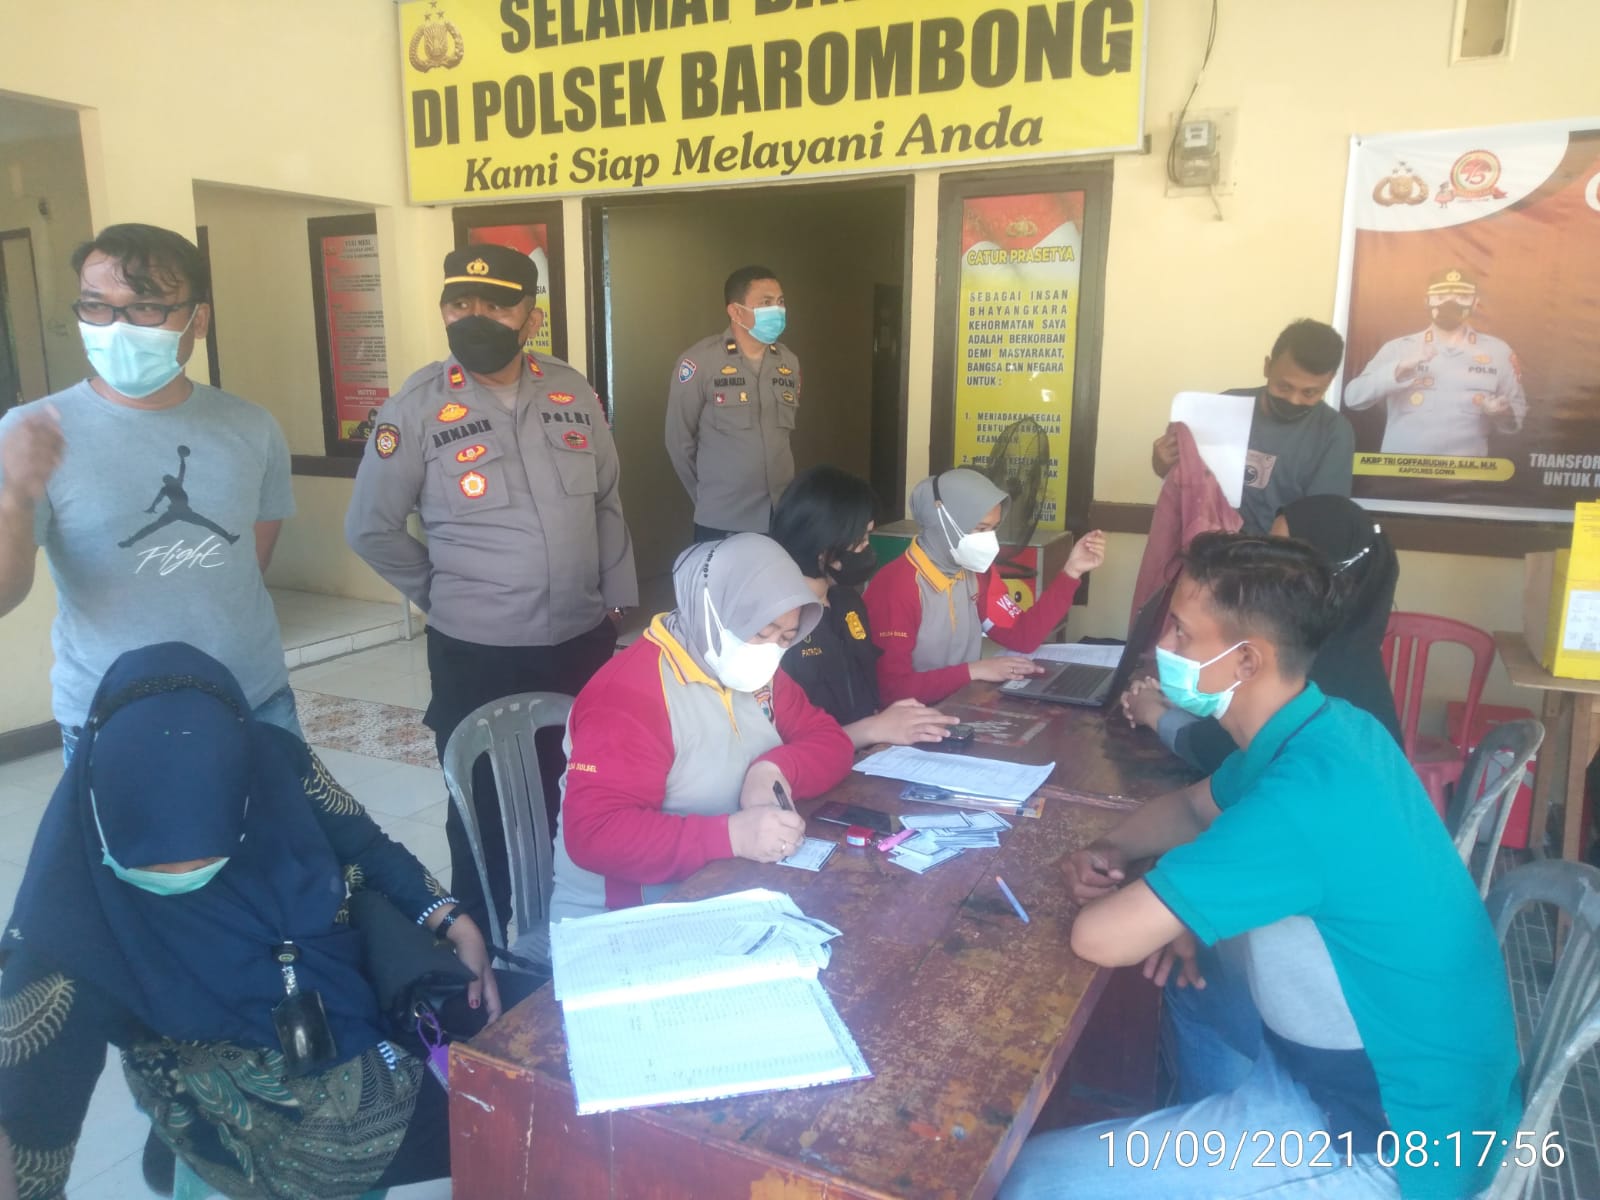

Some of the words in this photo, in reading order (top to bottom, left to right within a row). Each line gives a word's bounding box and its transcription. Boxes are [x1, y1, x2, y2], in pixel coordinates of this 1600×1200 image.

[412, 85, 460, 148] DI
[472, 56, 667, 142] POLSEK
[681, 0, 1134, 120] BAROMBONG
[464, 152, 559, 192] Kami
[569, 147, 660, 187] Siap
[672, 120, 885, 175] Melayani
[895, 105, 1043, 157] Anda
[967, 249, 1007, 265] CATUR
[1009, 246, 1074, 263] PRASETYA
[970, 291, 1022, 301] SEBAGAI
[1030, 289, 1068, 300] INSAN
[969, 304, 1068, 316] BHAYANGKARA
[968, 320, 1034, 330] KEHORMATAN
[1042, 319, 1066, 329] SAYA
[968, 334, 1003, 344] ADALAH
[1009, 333, 1065, 344] BERKORBAN
[967, 349, 992, 358] DEMI
[967, 362, 1002, 372] BANGSA
[1005, 362, 1024, 372] DAN
[1027, 362, 1064, 372] NEGARA
[967, 376, 996, 386] UNTUK
[541, 412, 592, 427] POLRI
[1360, 456, 1382, 465] AKBP
[1384, 457, 1396, 466] TRI
[1543, 471, 1591, 487] UNTUK
[135, 535, 224, 576] Flight
